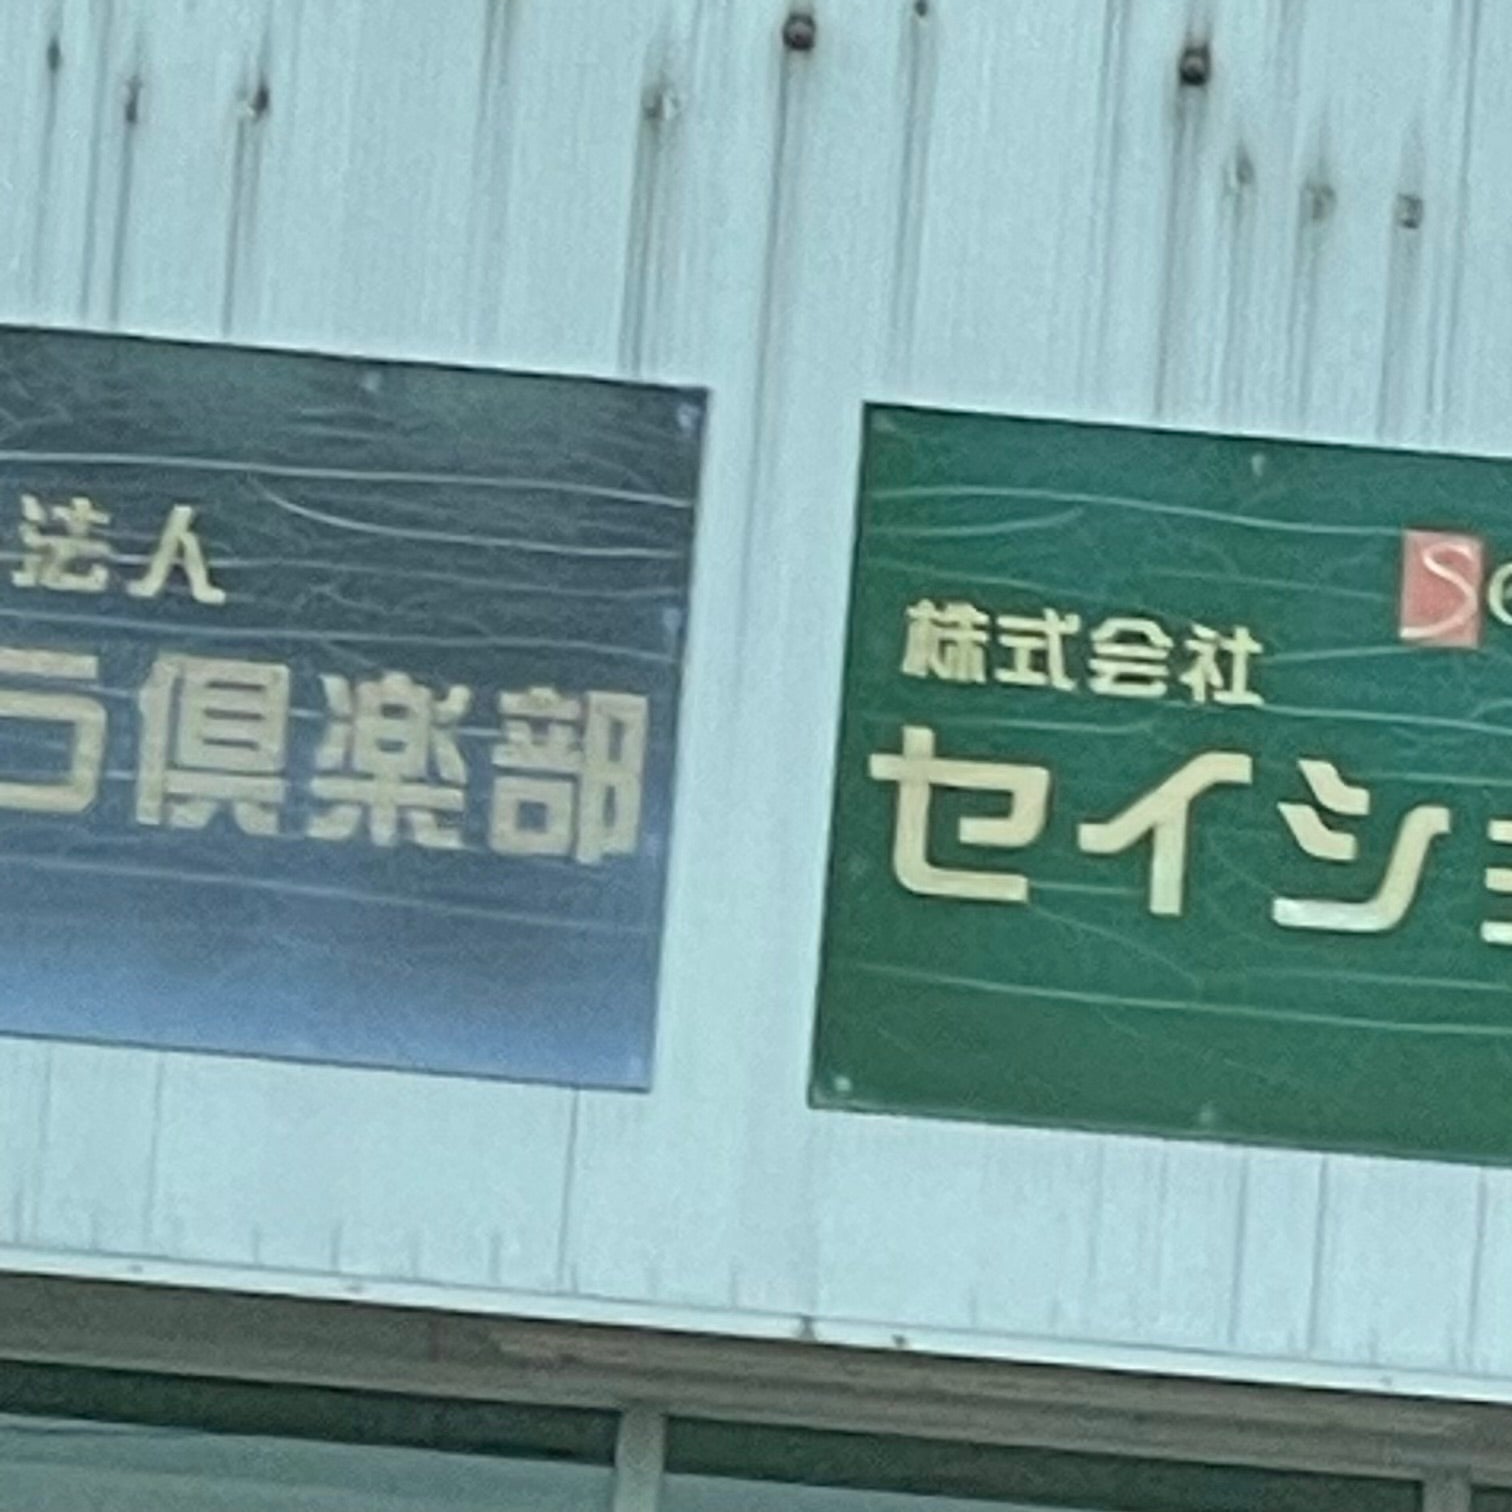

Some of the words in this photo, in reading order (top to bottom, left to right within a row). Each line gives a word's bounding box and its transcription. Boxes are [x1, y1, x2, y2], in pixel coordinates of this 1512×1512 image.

[12, 493, 227, 604] 法人
[901, 598, 1264, 706] 株式会社
